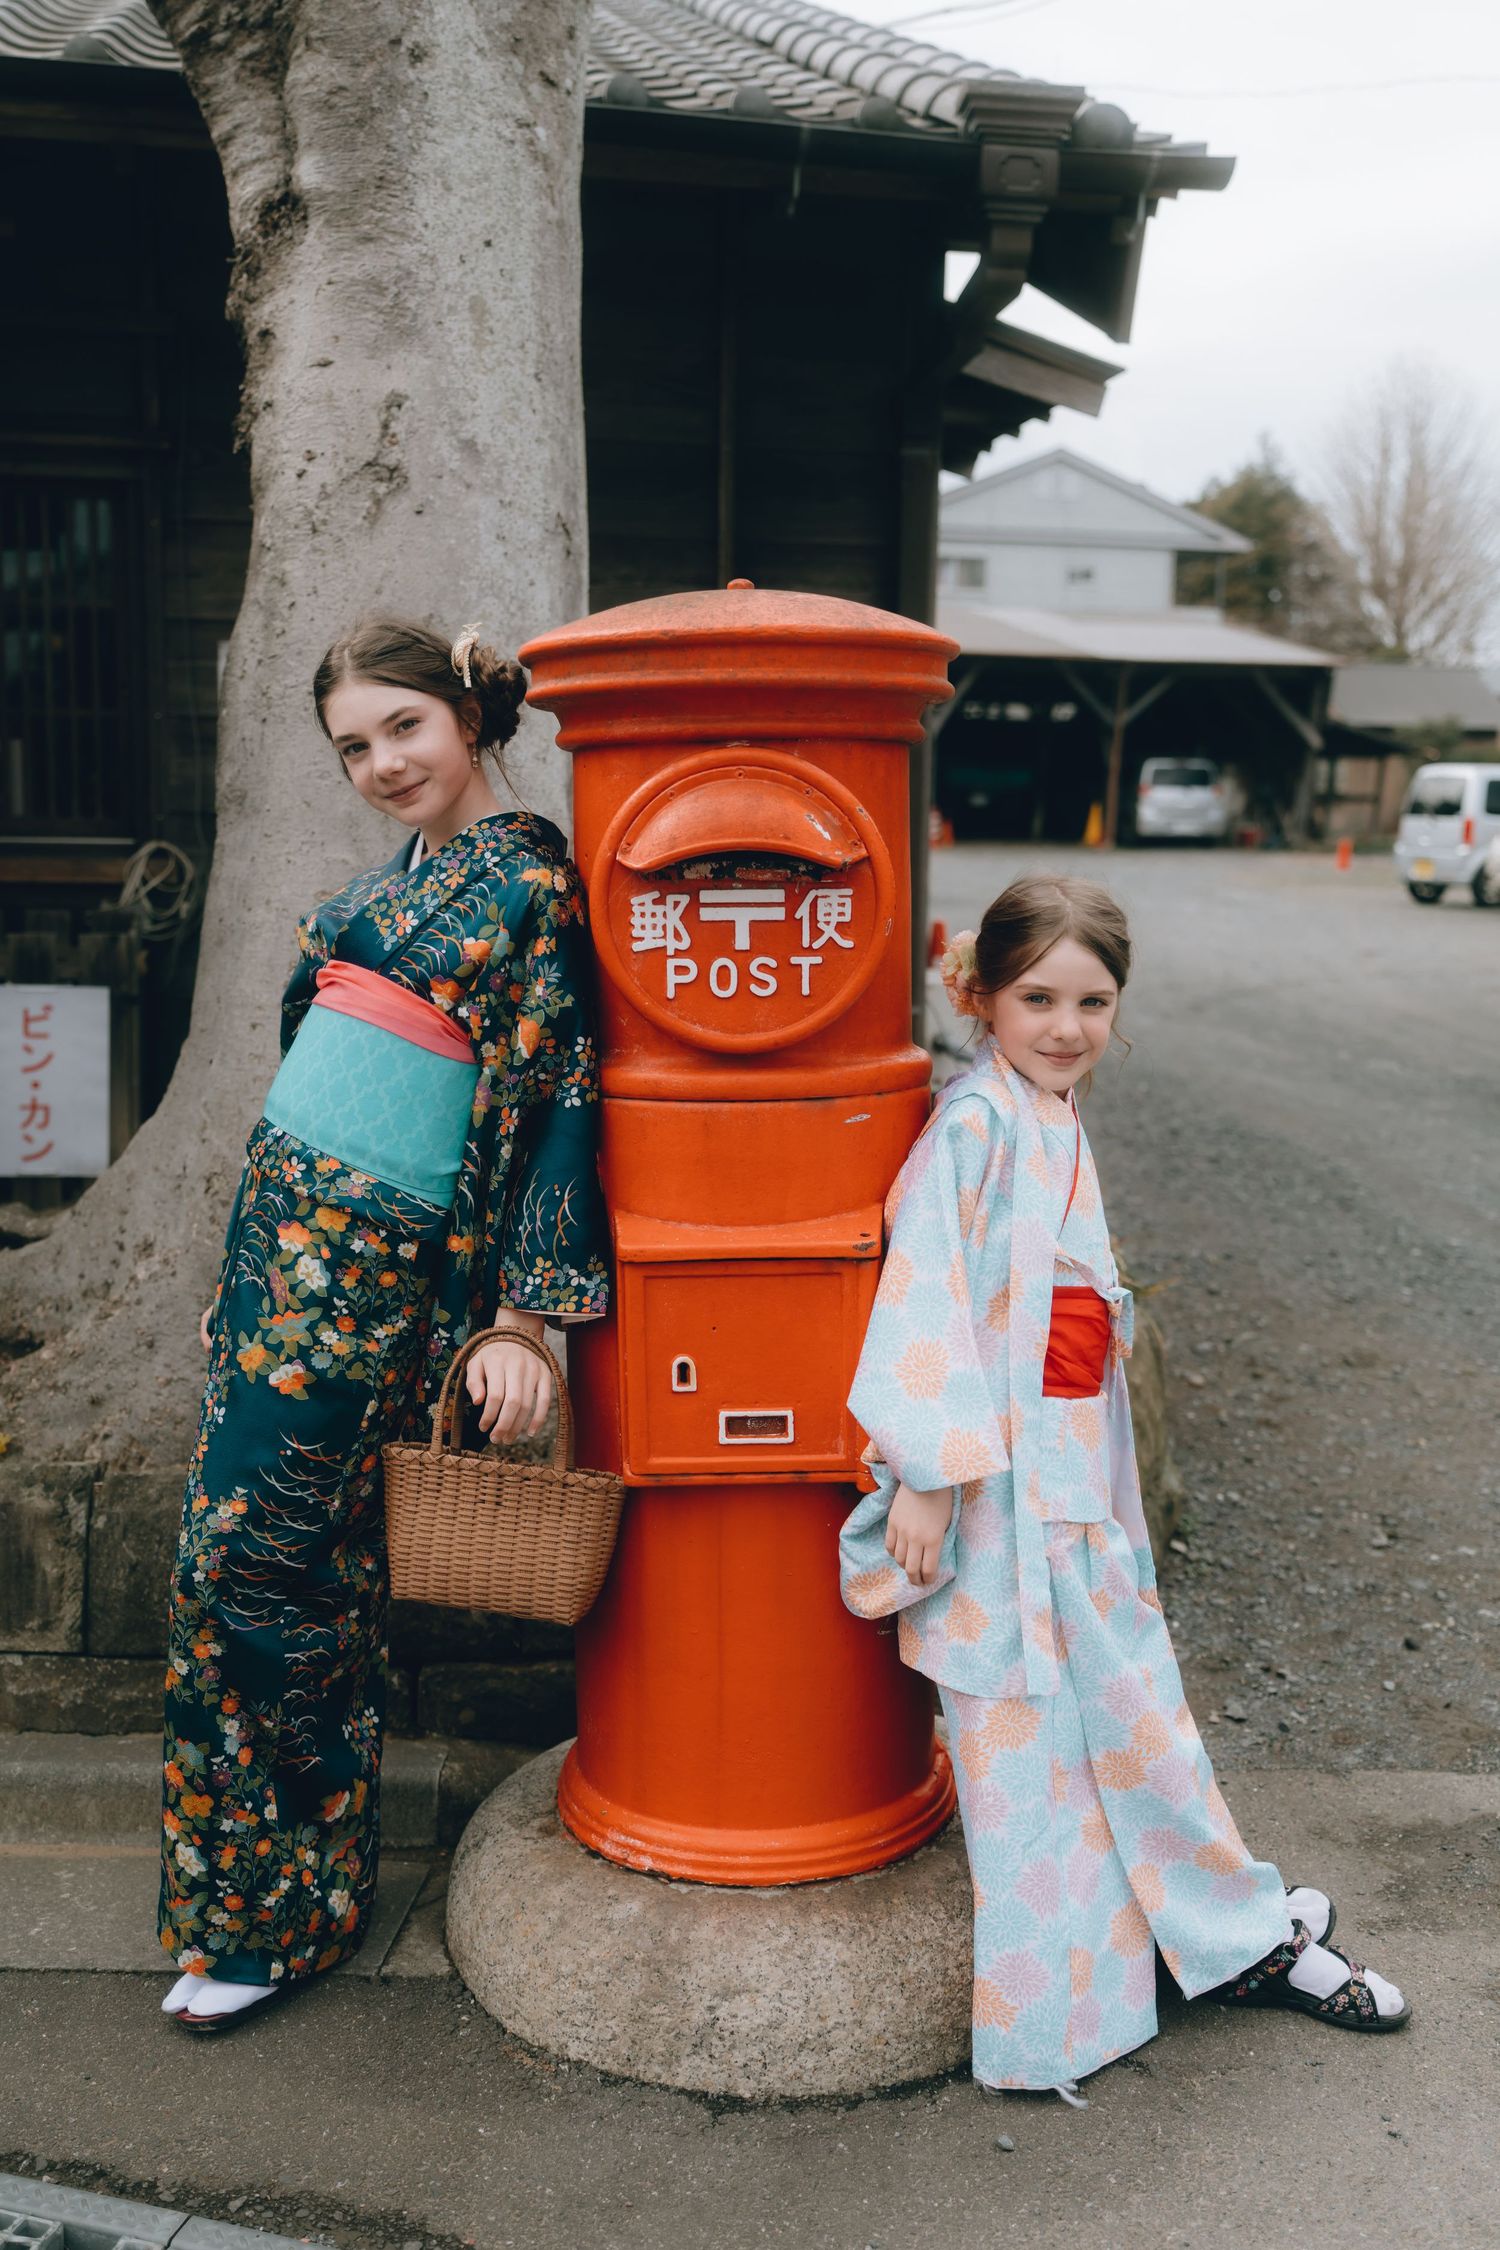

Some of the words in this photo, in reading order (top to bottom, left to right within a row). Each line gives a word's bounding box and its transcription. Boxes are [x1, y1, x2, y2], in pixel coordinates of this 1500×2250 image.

[666, 956, 823, 1000] POST
[20, 1004, 54, 1163] ビン・カン
